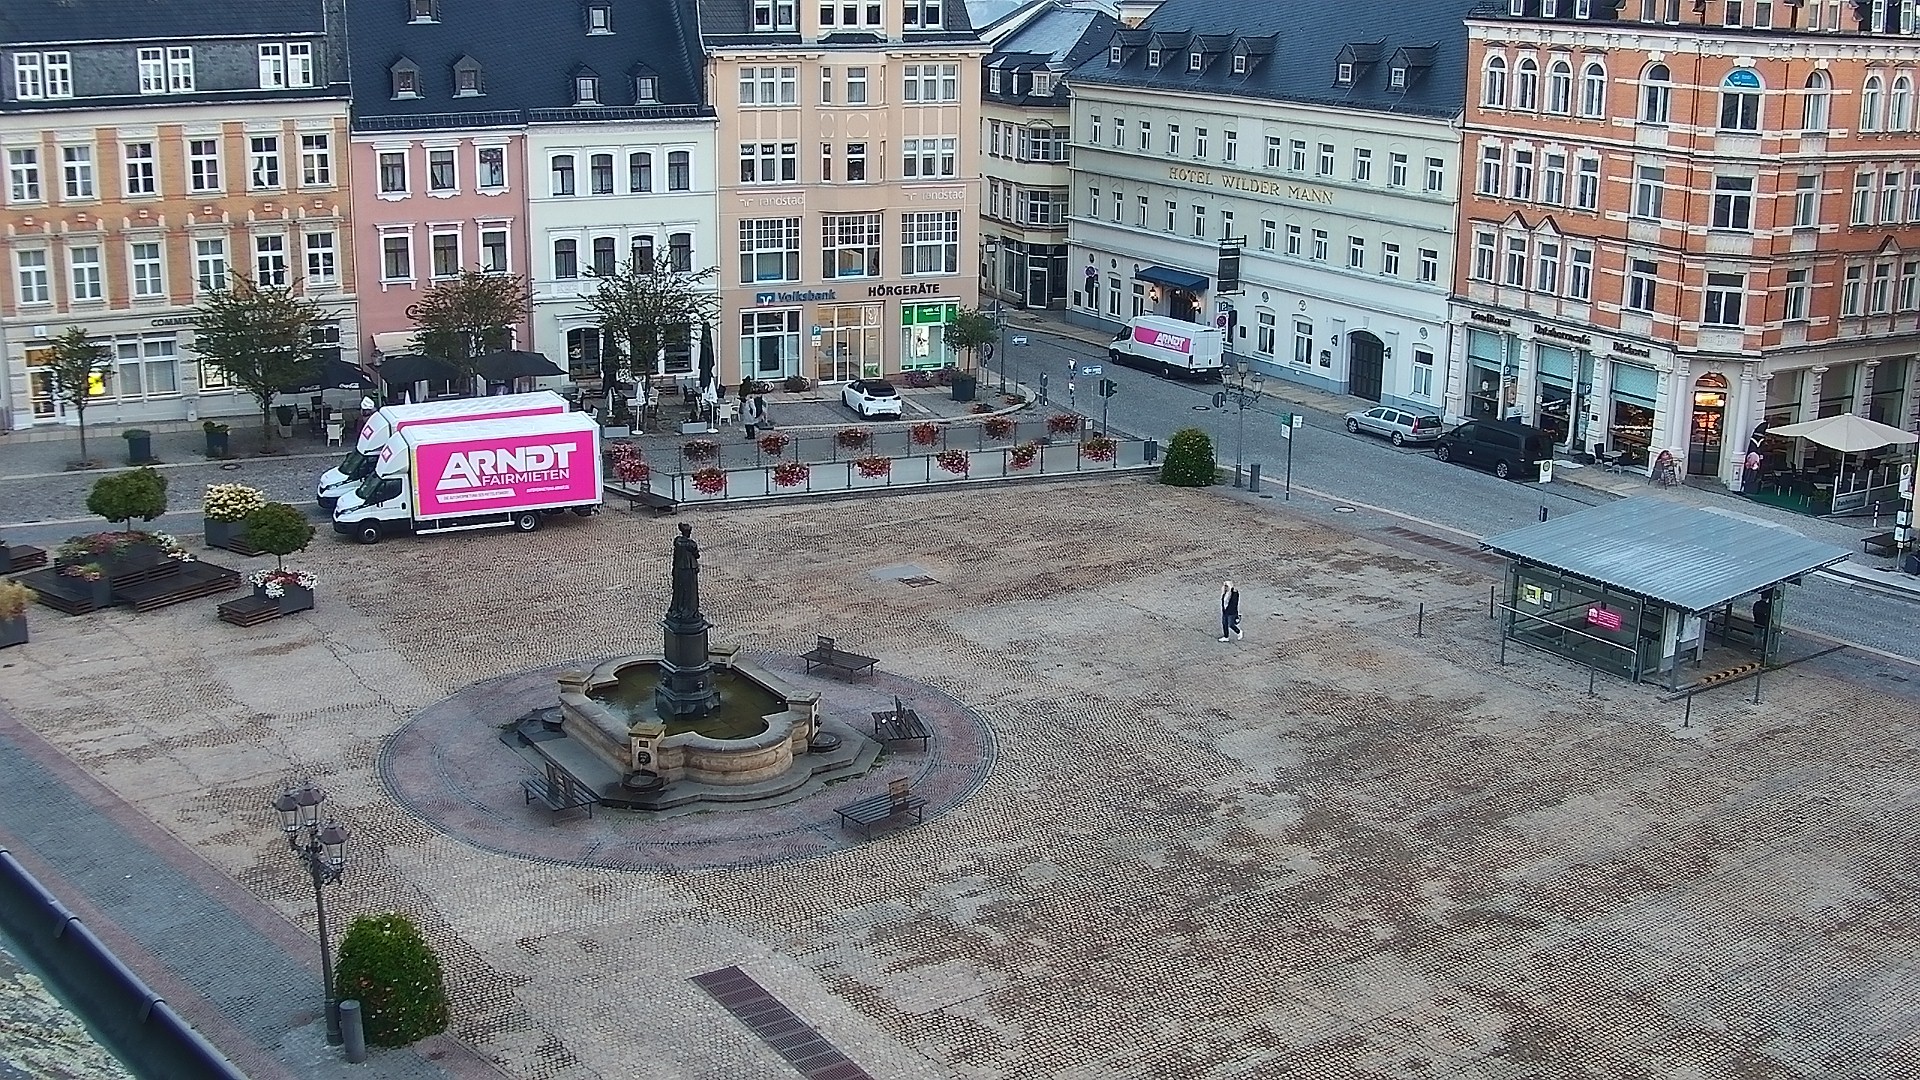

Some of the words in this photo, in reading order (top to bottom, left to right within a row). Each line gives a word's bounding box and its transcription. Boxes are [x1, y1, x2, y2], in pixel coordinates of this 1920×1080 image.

[1169, 166, 1213, 186] HOTEL
[1221, 174, 1280, 197] WILDER
[1288, 185, 1334, 205] MANN
[759, 193, 805, 206] randstad
[922, 187, 965, 200] randstad
[777, 289, 837, 303] Volksbank
[868, 283, 940, 297] HÖRGERÄTE
[1153, 332, 1186, 348] ARNDT
[435, 442, 577, 490] ARNDT
[482, 468, 570, 487] FAIRMIETEN
